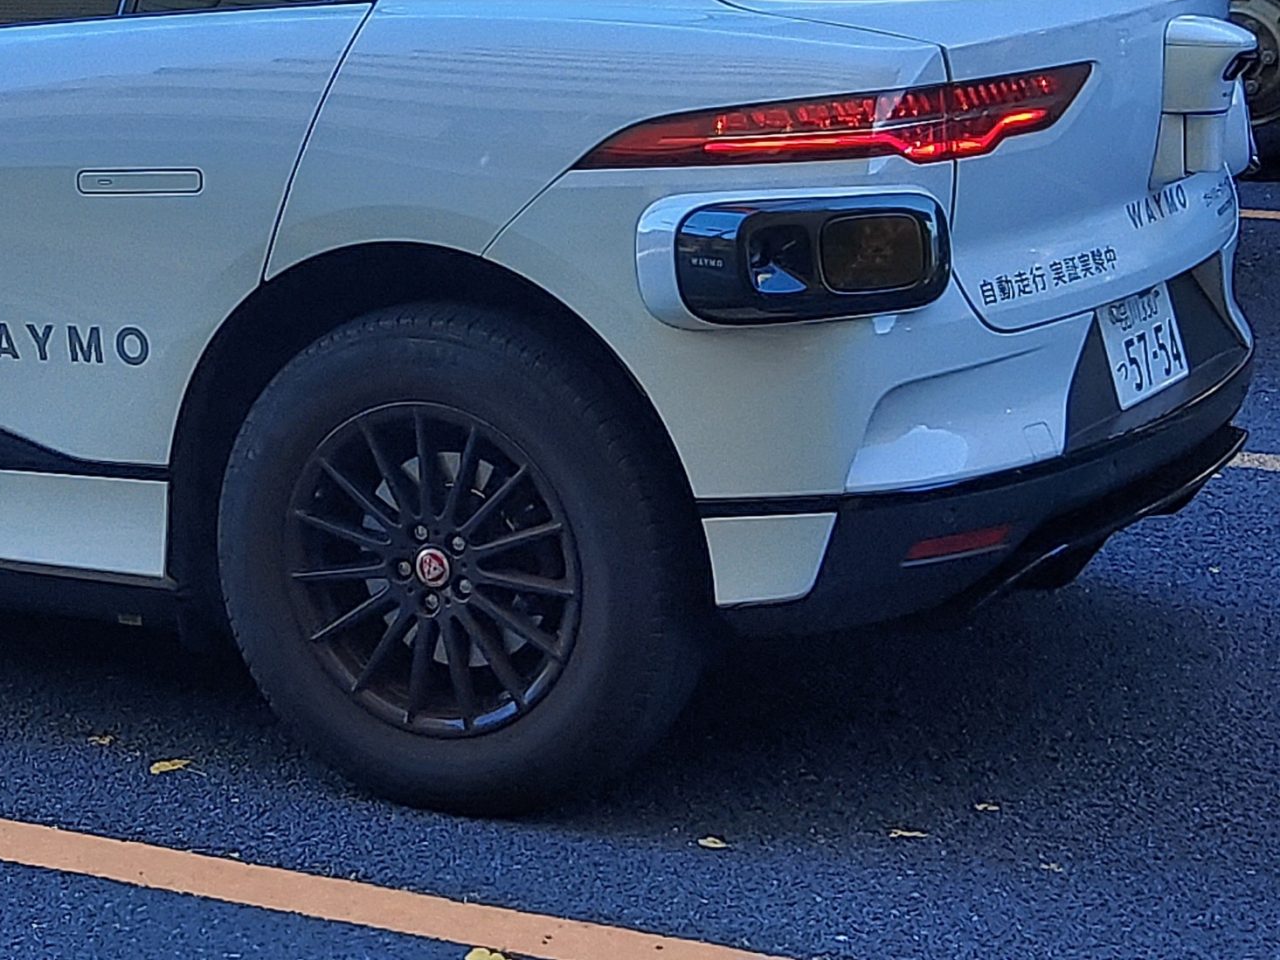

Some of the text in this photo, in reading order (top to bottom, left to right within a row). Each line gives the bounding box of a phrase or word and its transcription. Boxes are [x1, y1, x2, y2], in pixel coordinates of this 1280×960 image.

[1126, 183, 1187, 230] WAYMO
[690, 257, 723, 268] WAYMO
[980, 245, 1117, 306] 自動走行 実証実験中
[1124, 318, 1184, 392] 57-54
